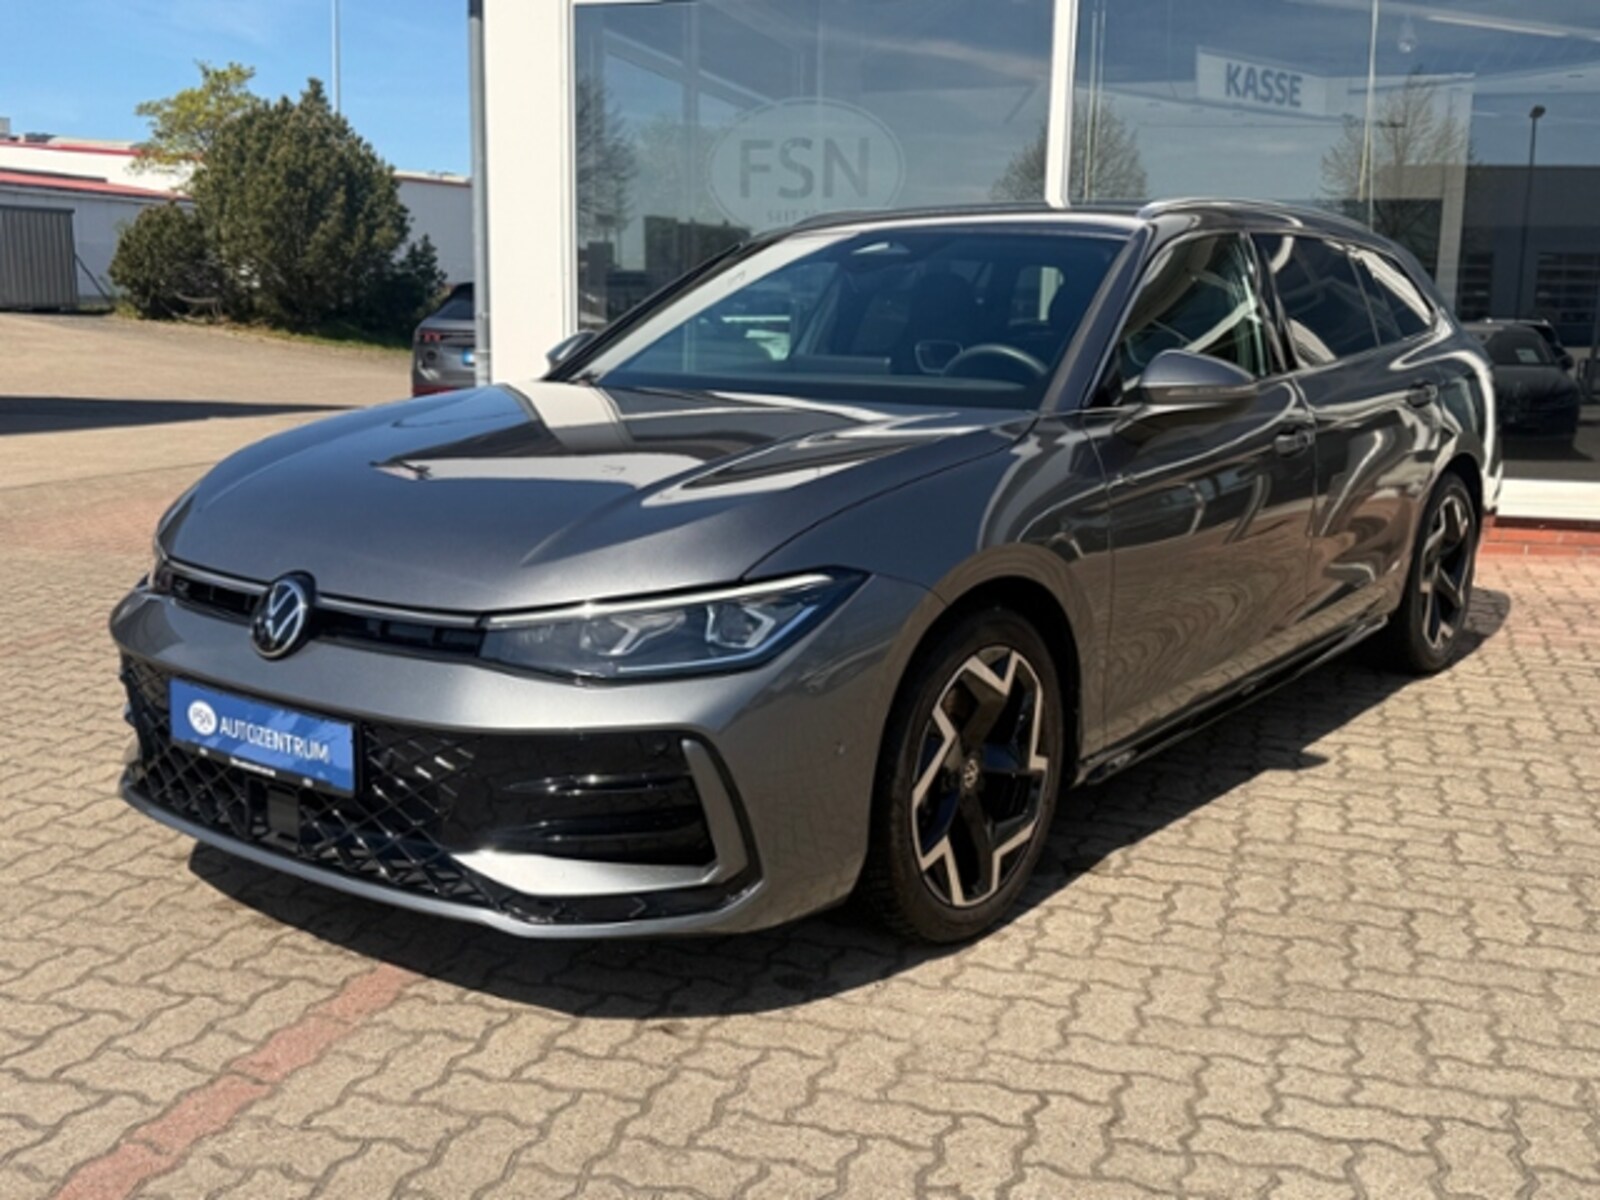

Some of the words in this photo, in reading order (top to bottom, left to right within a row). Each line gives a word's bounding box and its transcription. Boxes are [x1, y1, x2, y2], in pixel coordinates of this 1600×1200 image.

[1224, 62, 1303, 108] KASSE
[739, 136, 871, 200] FSN
[219, 716, 330, 764] AUTOZENTRUM
